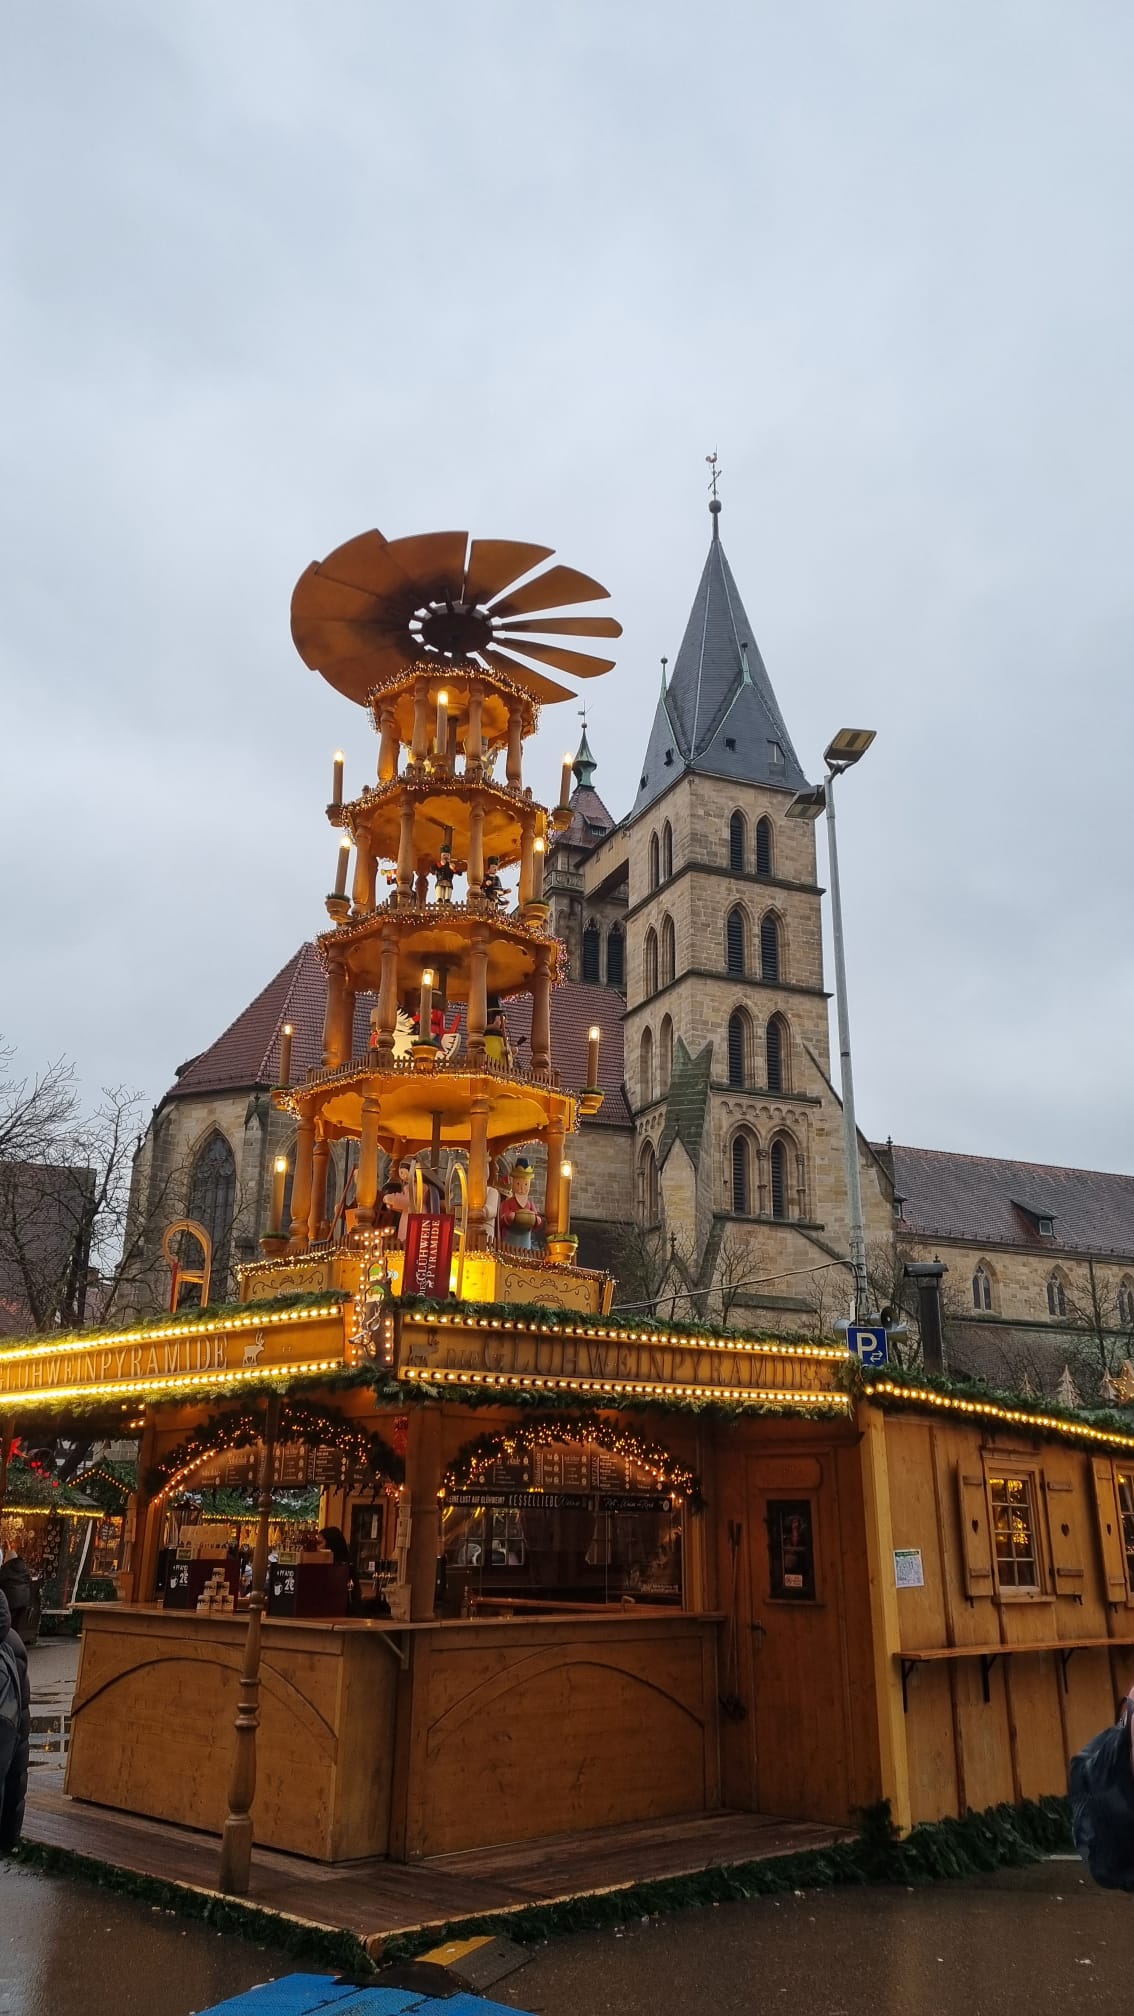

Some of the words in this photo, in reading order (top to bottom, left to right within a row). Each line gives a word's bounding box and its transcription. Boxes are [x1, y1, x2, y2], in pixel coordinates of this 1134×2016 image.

[426, 1220, 440, 1278] PYRAMIDE
[856, 1333, 878, 1358] P
[284, 1576, 295, 1591] 2€
